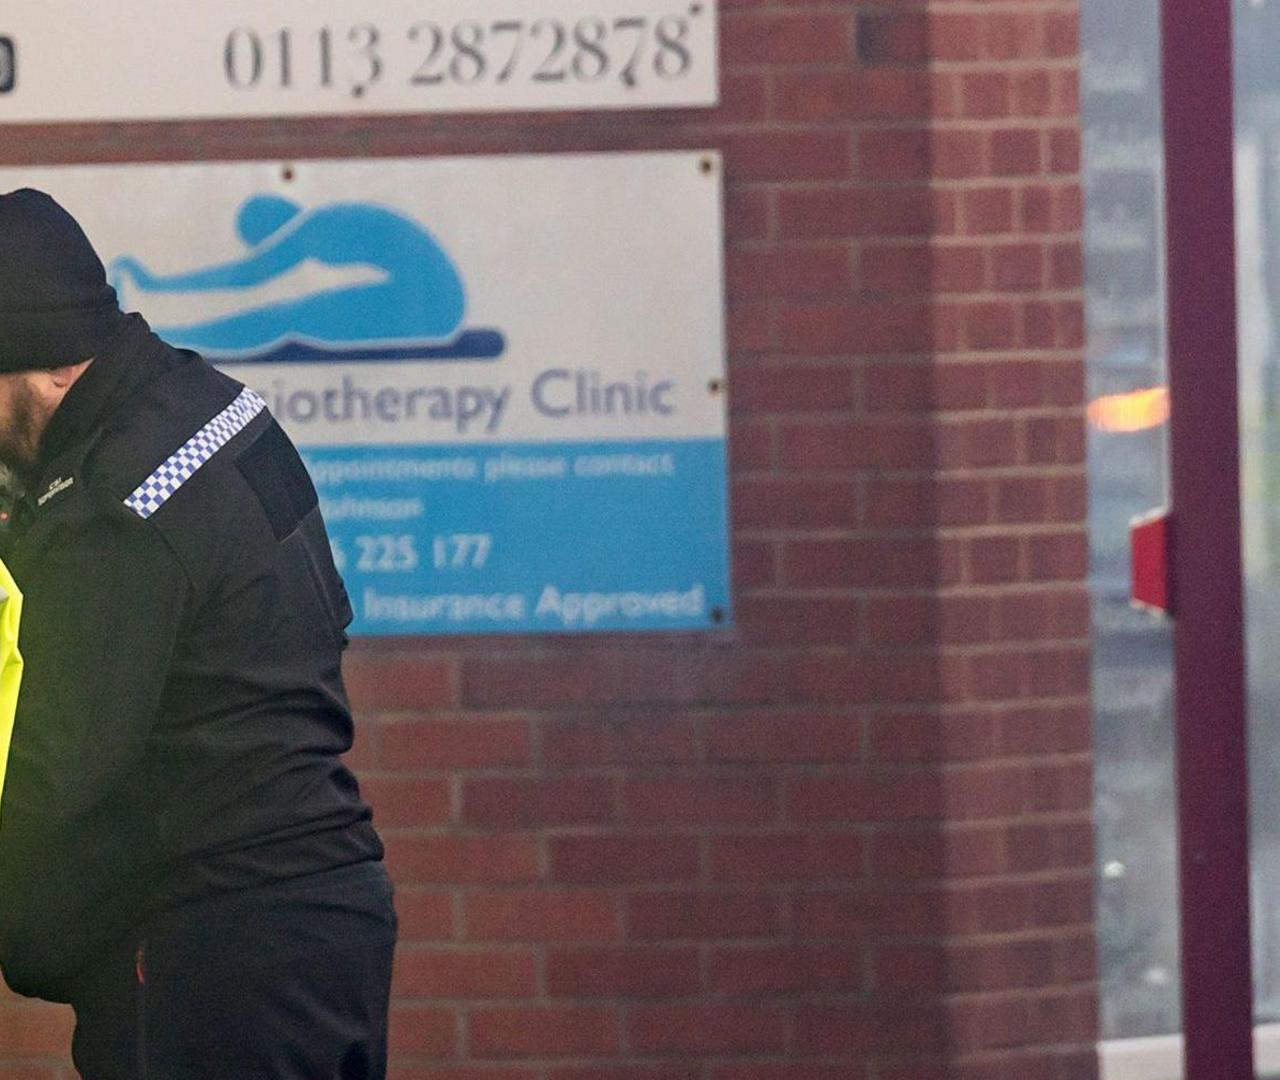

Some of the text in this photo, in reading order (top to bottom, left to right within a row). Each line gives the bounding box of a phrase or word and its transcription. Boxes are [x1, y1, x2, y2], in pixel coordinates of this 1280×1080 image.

[223, 15, 693, 98] 0113 2872878
[258, 368, 674, 434] iotherapy Clinic
[355, 535, 418, 572] 225
[433, 533, 491, 568] 177
[364, 583, 704, 624] Insurance Approved
